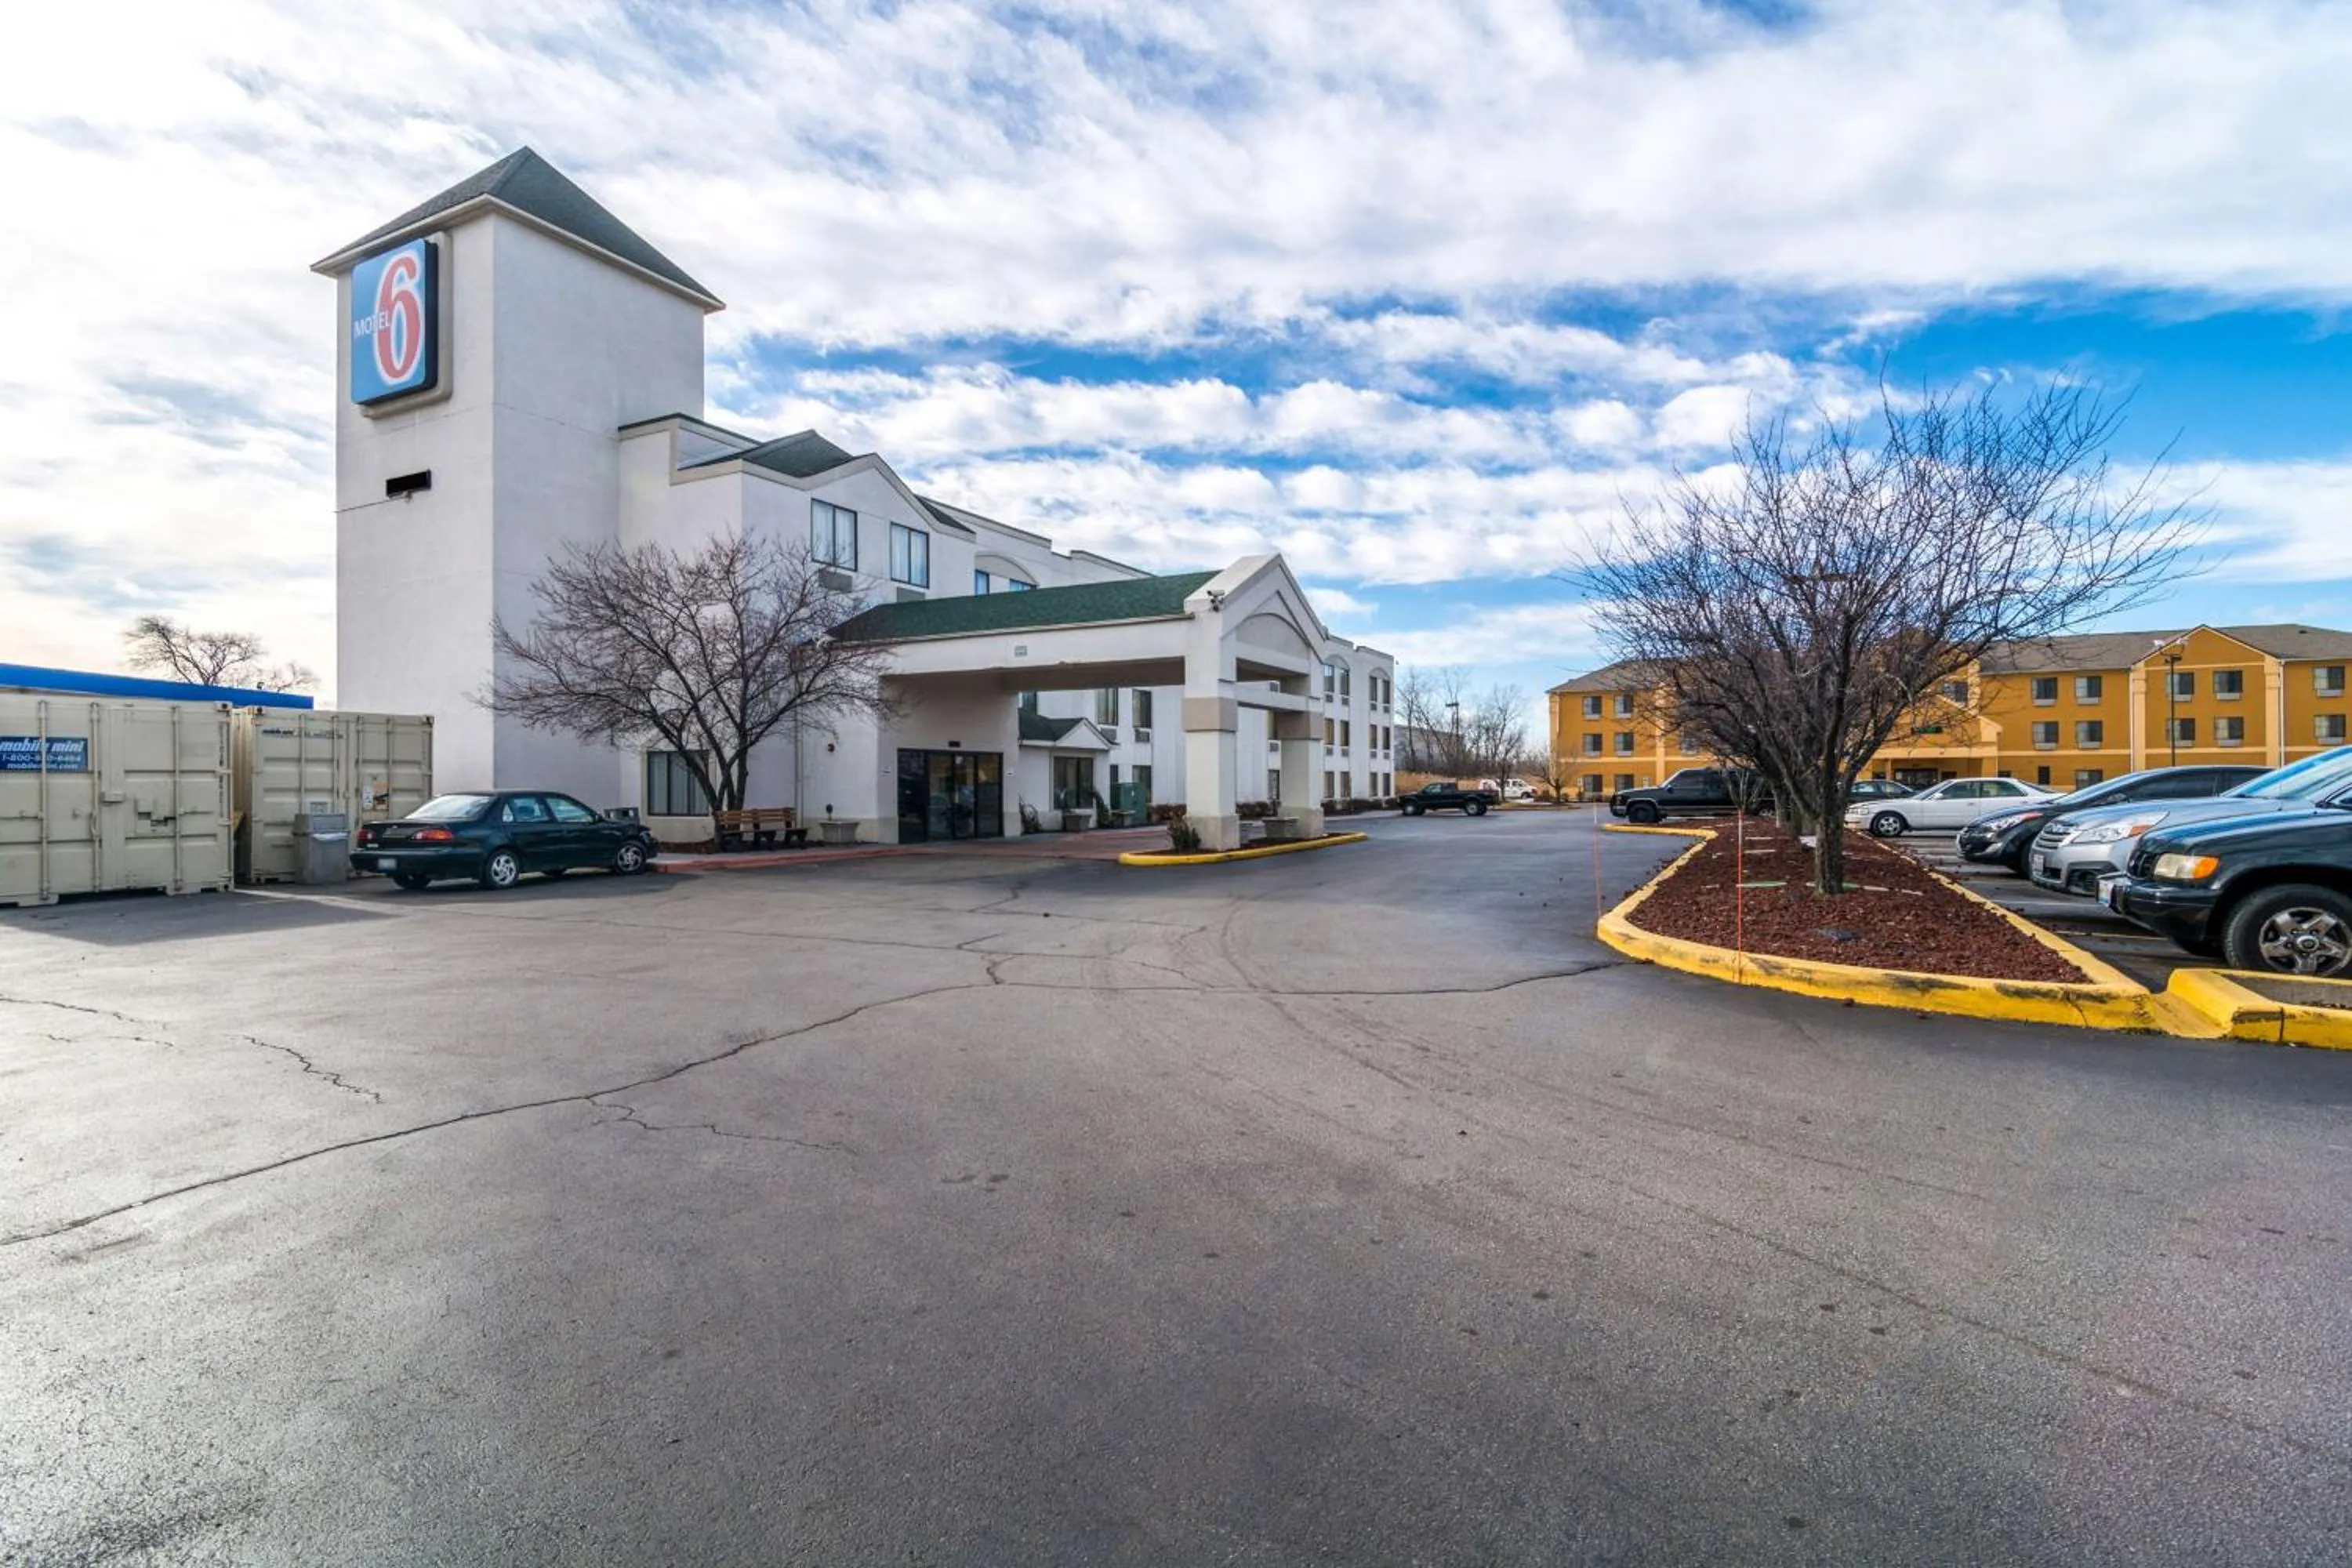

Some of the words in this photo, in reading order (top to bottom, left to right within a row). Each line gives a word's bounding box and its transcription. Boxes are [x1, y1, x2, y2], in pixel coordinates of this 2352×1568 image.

[354, 310, 390, 337] MOTEL
[374, 251, 422, 385] 6
[51, 740, 84, 752] mini
